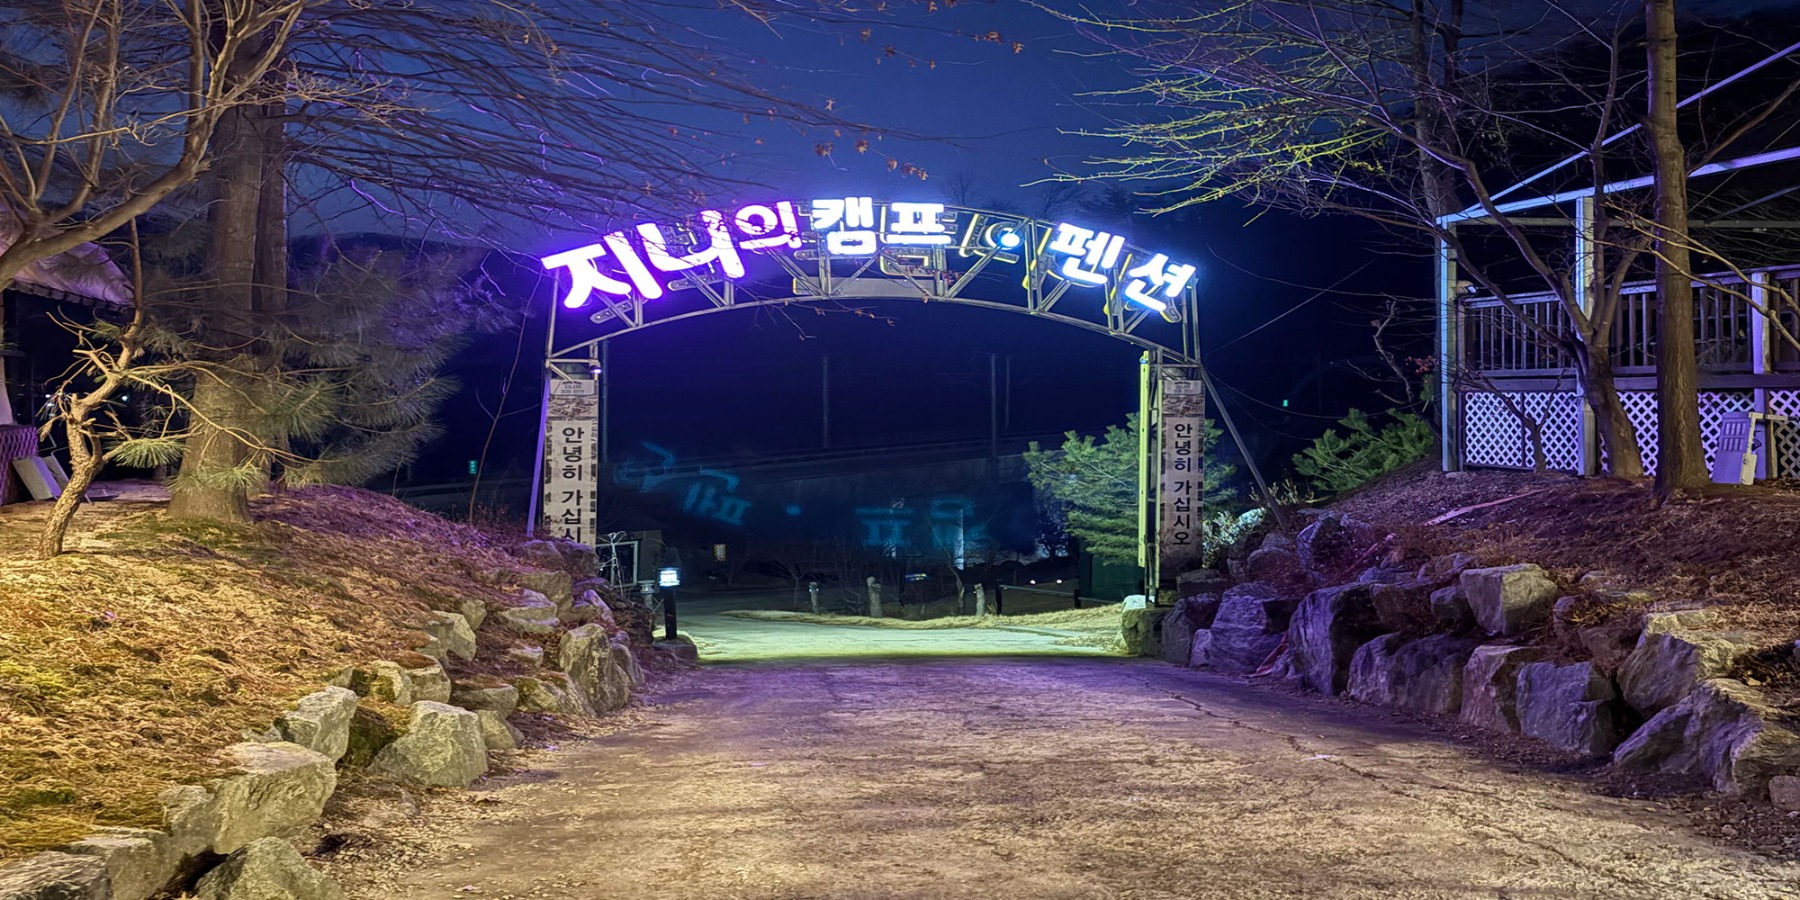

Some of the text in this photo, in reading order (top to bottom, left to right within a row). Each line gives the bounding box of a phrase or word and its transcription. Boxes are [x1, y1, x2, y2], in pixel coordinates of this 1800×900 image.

[541, 196, 1197, 312] 지니의 캠프 펜션
[561, 427, 584, 543] 안녕히 가십시
[1173, 423, 1192, 546] 안녕히 가십시오
